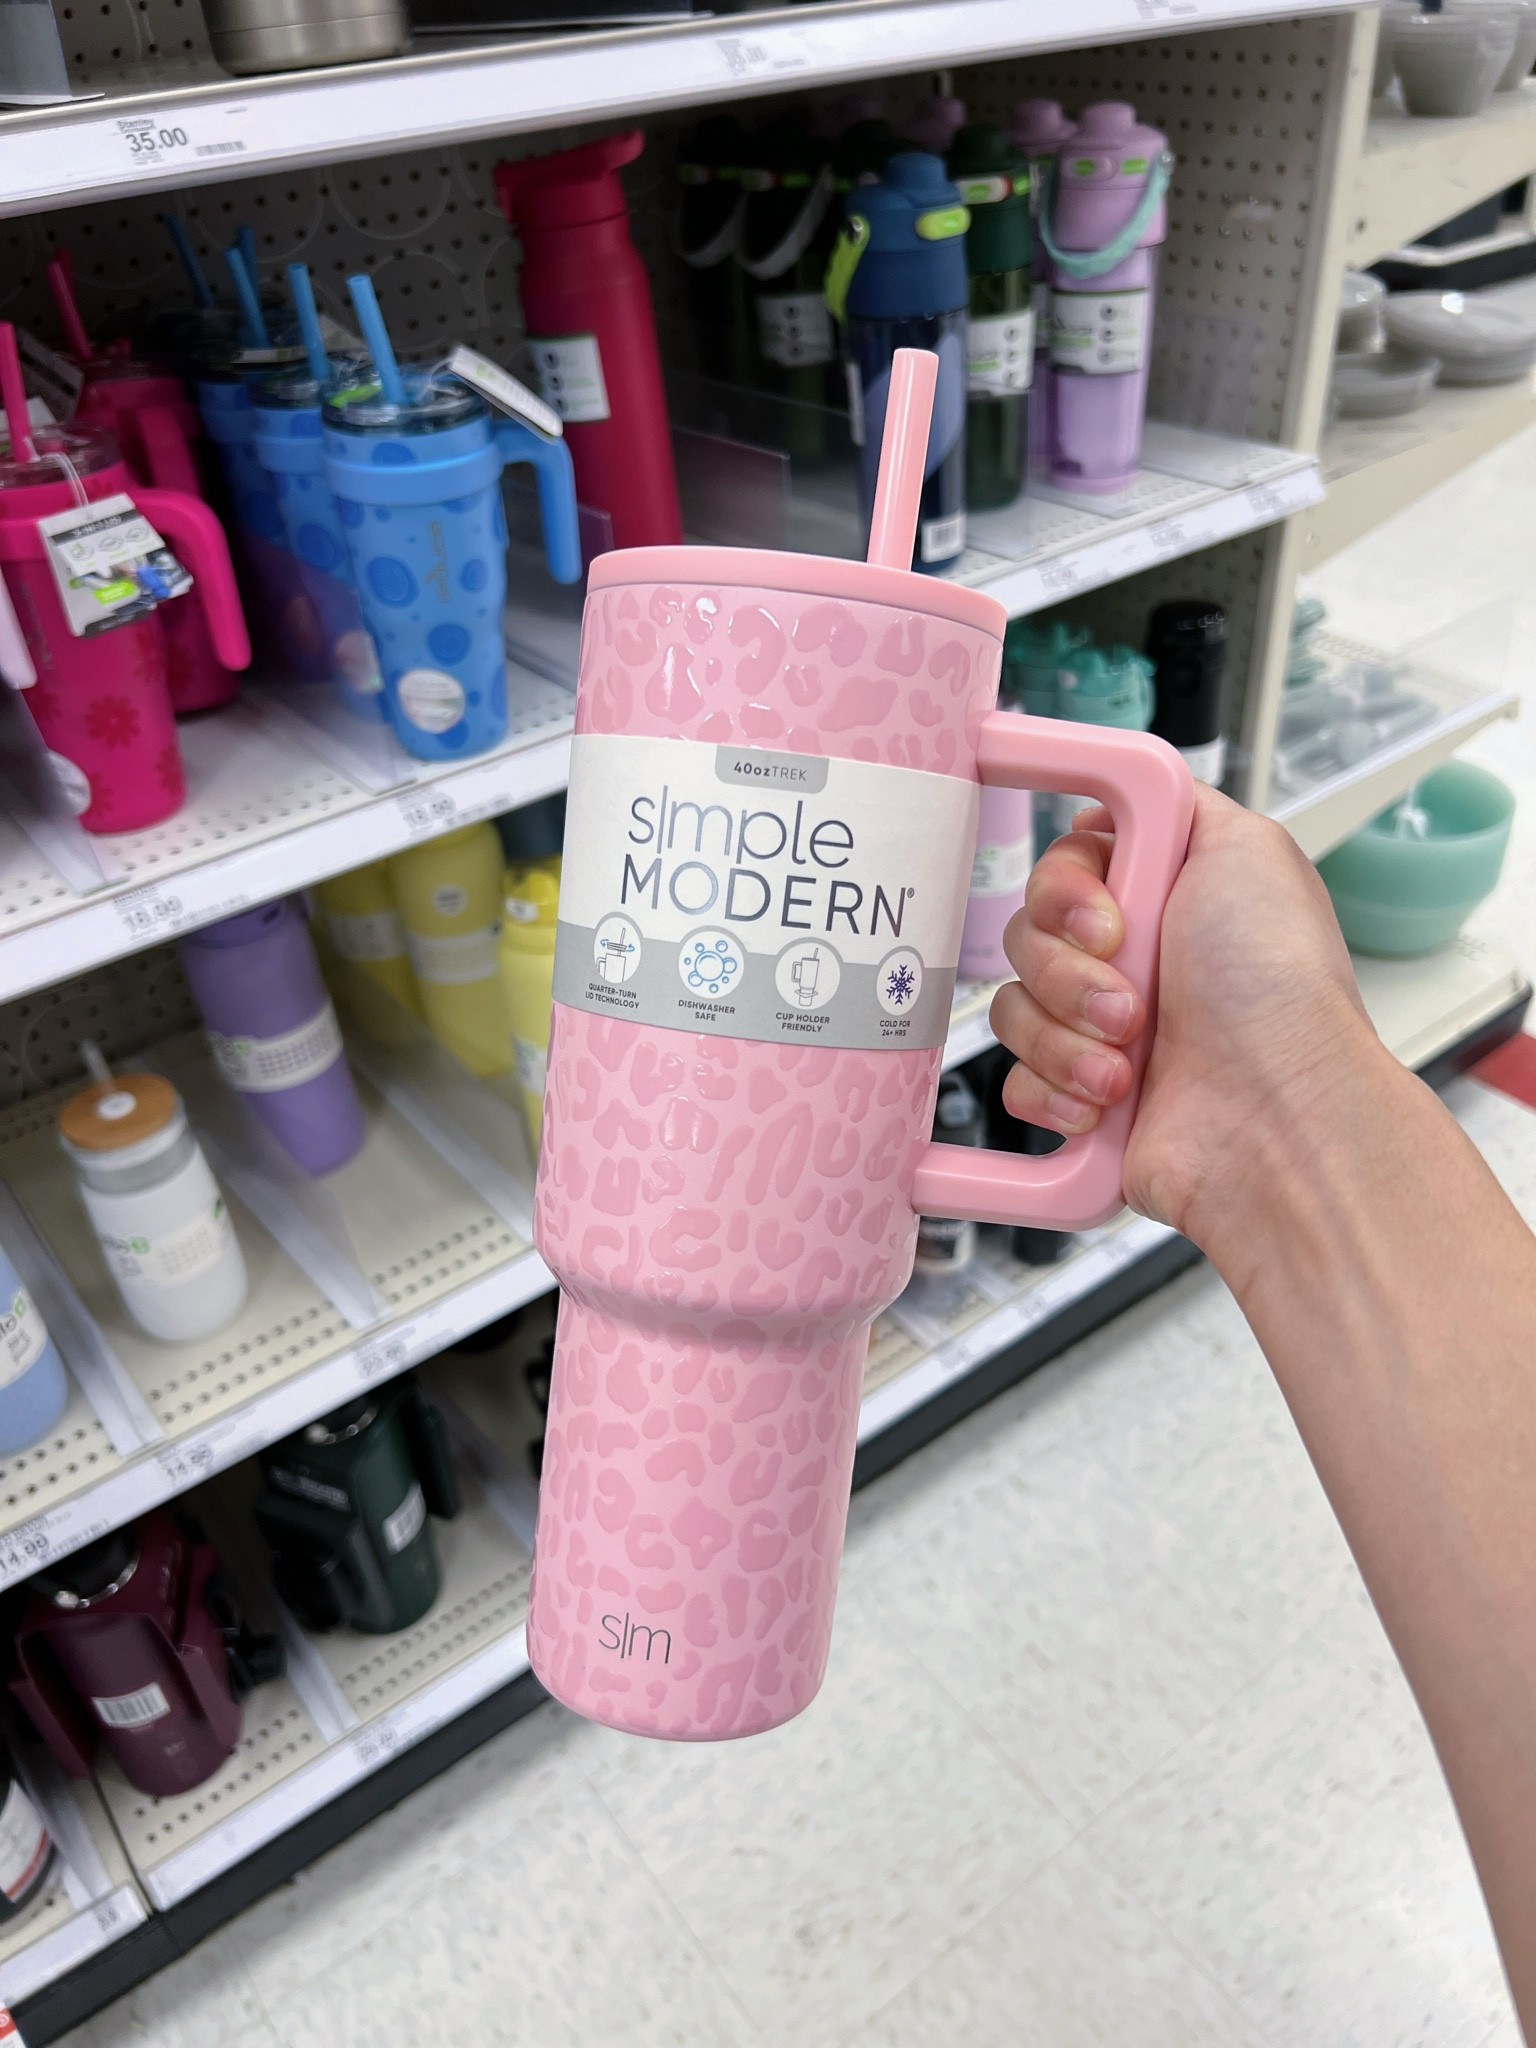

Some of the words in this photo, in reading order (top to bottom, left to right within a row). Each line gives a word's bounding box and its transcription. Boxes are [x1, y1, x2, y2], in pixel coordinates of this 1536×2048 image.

[126, 128, 188, 152] 35.00
[589, 983, 637, 999] QUARTER-TURN
[585, 991, 594, 999] LID
[595, 994, 640, 1009] TECHNOLOGY
[678, 999, 735, 1014] DISHWASHER
[695, 1012, 716, 1021] SAFE
[775, 1012, 794, 1020] CUP
[796, 1014, 830, 1024] HOLDER
[781, 1022, 822, 1032] FRIENDLY
